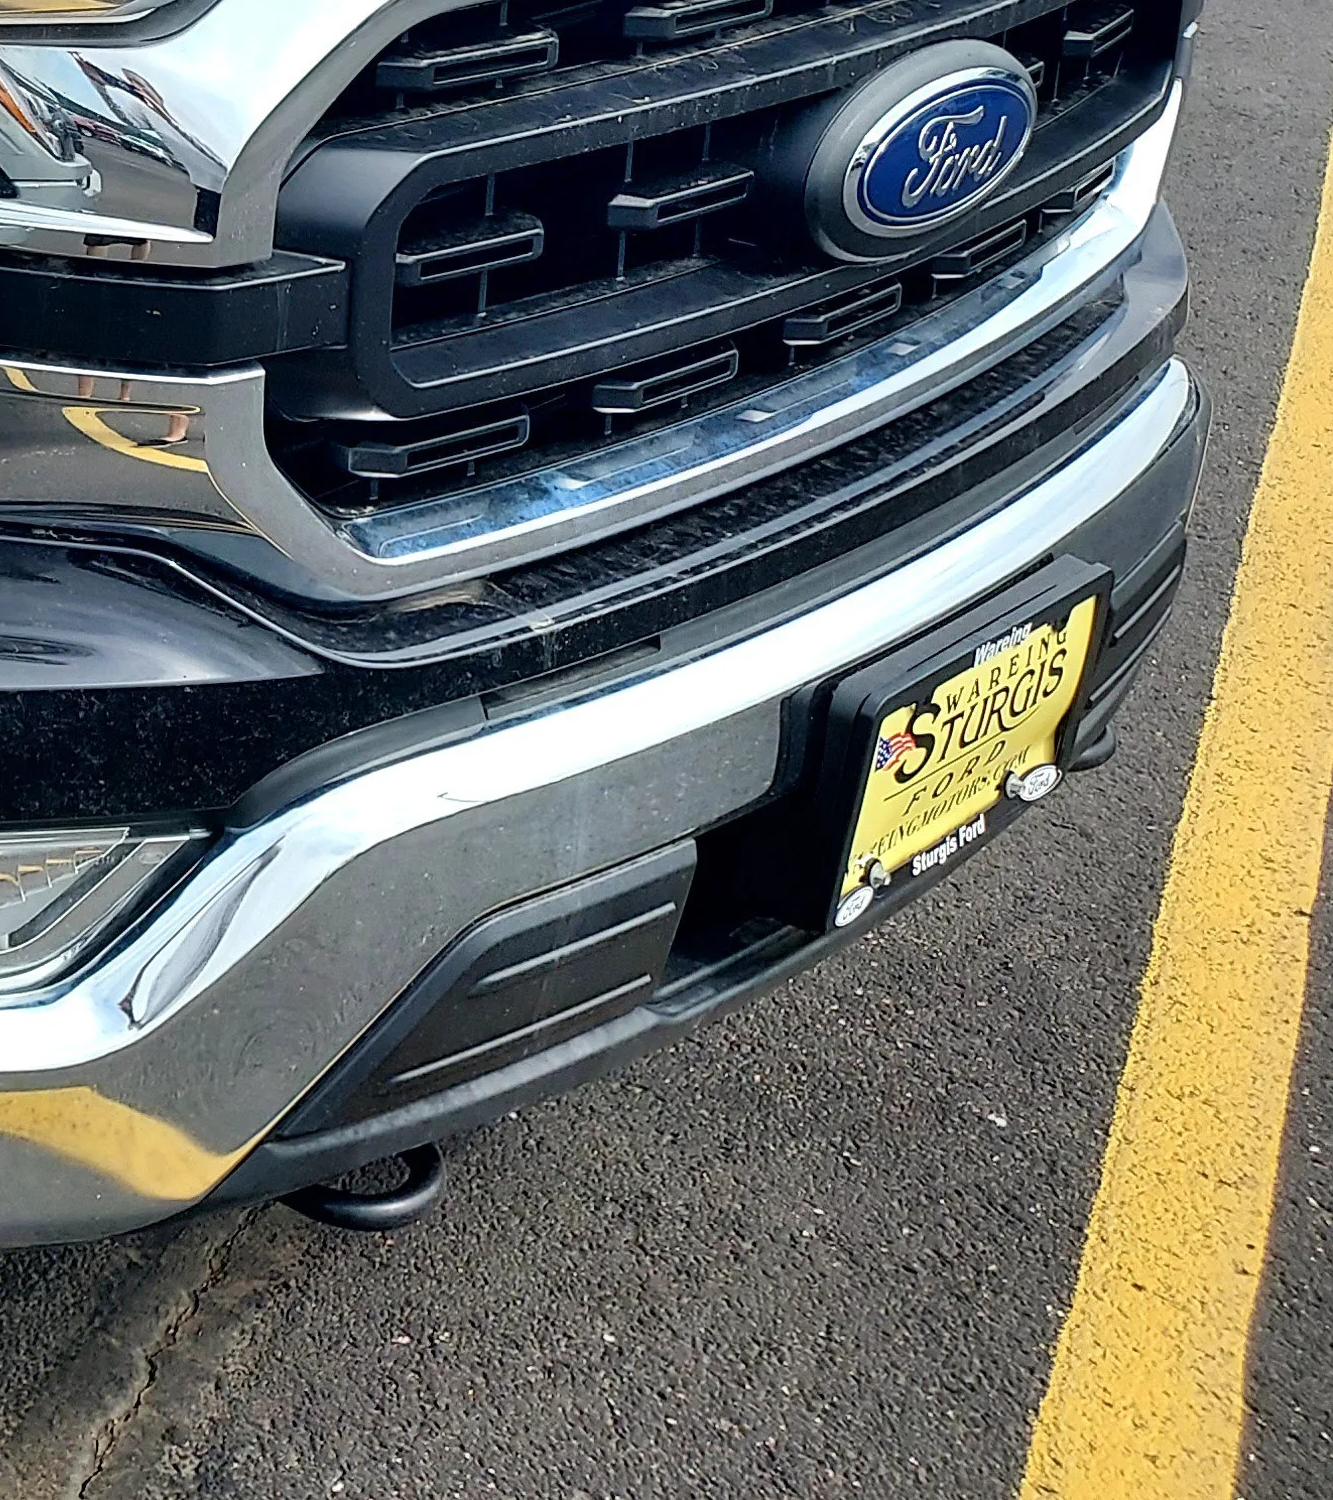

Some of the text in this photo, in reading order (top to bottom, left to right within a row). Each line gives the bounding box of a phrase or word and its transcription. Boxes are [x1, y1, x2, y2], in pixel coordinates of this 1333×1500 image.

[901, 105, 1007, 209] Ford
[973, 621, 1033, 668] Wareing
[894, 647, 1068, 785] STURGIS
[902, 739, 1007, 817] FORD
[912, 813, 986, 877] Sturgis Ford
